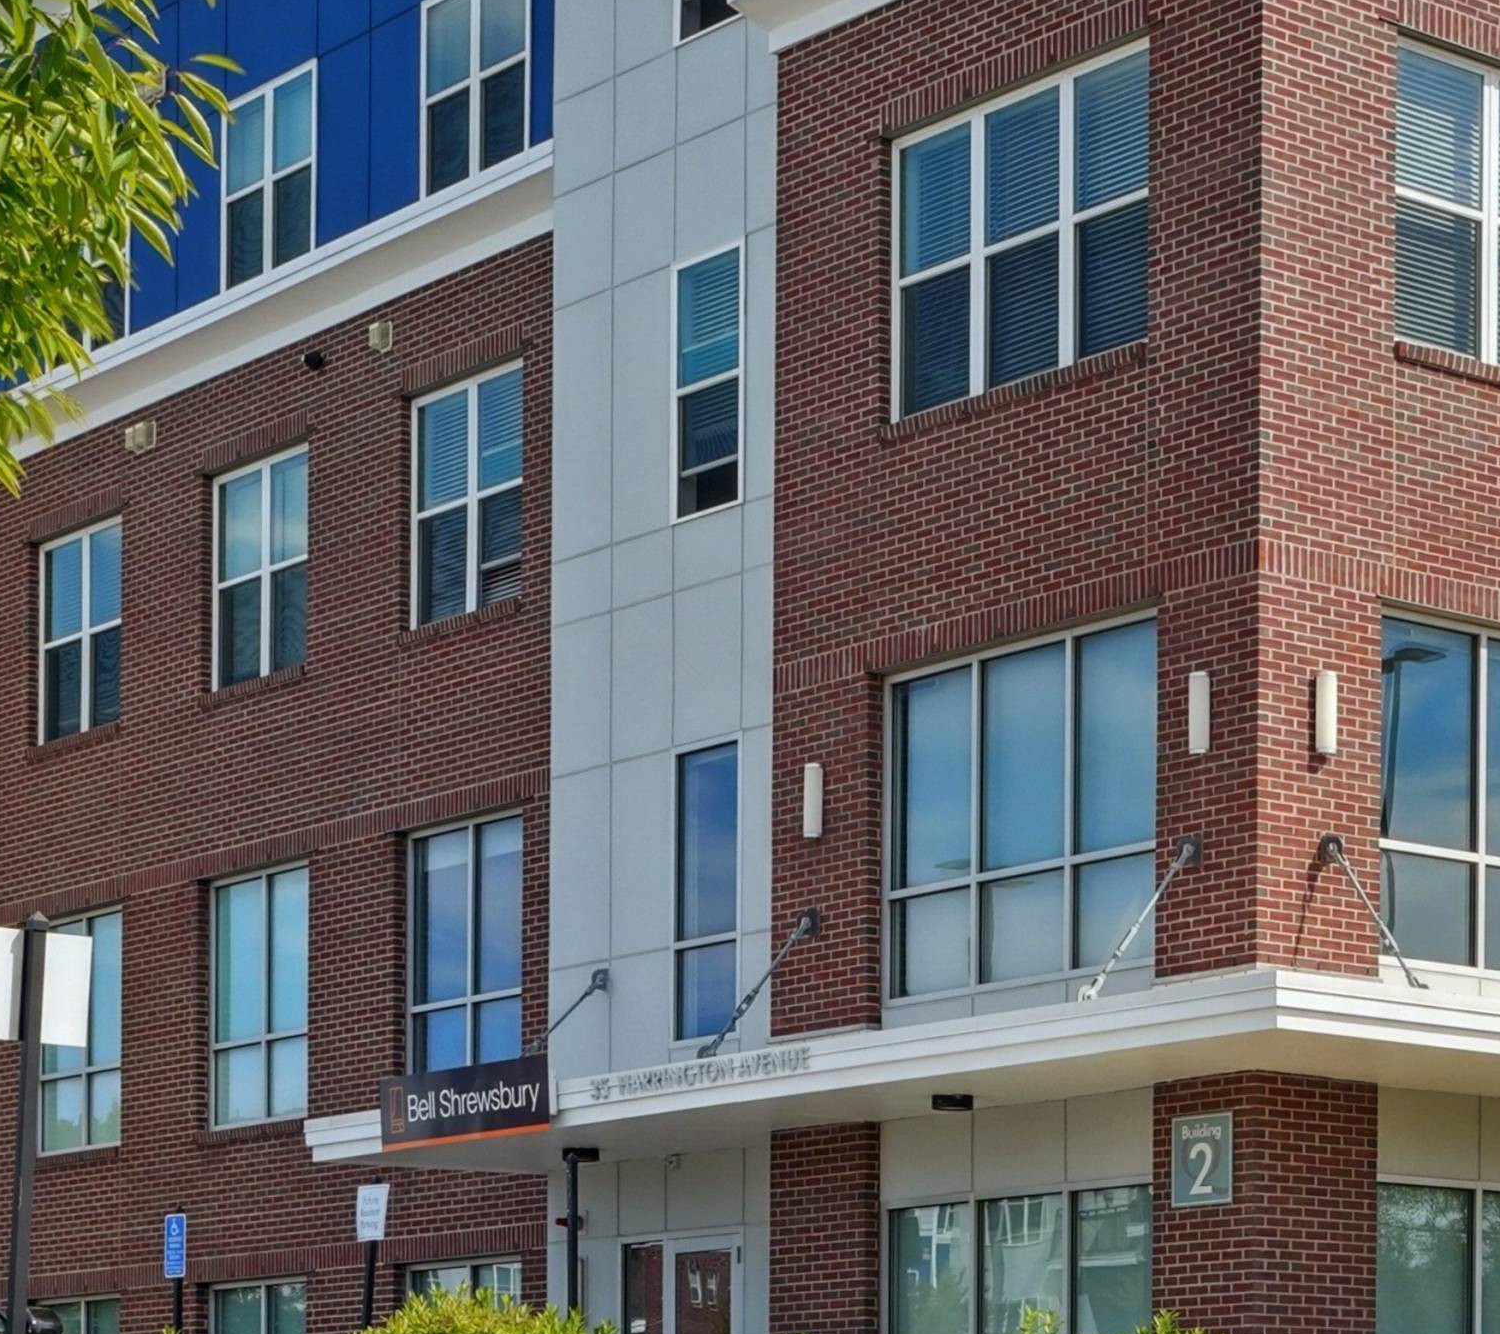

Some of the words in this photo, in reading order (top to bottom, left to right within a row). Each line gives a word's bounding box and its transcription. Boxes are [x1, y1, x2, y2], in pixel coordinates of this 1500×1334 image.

[590, 1077, 611, 1100] 35
[617, 1057, 734, 1096] HARRINGTON
[737, 1046, 811, 1079] AVENUE
[407, 1090, 435, 1123] Bell
[439, 1080, 540, 1118] Shrewsbury
[1181, 1123, 1221, 1140] Building
[1188, 1142, 1213, 1196] 2
